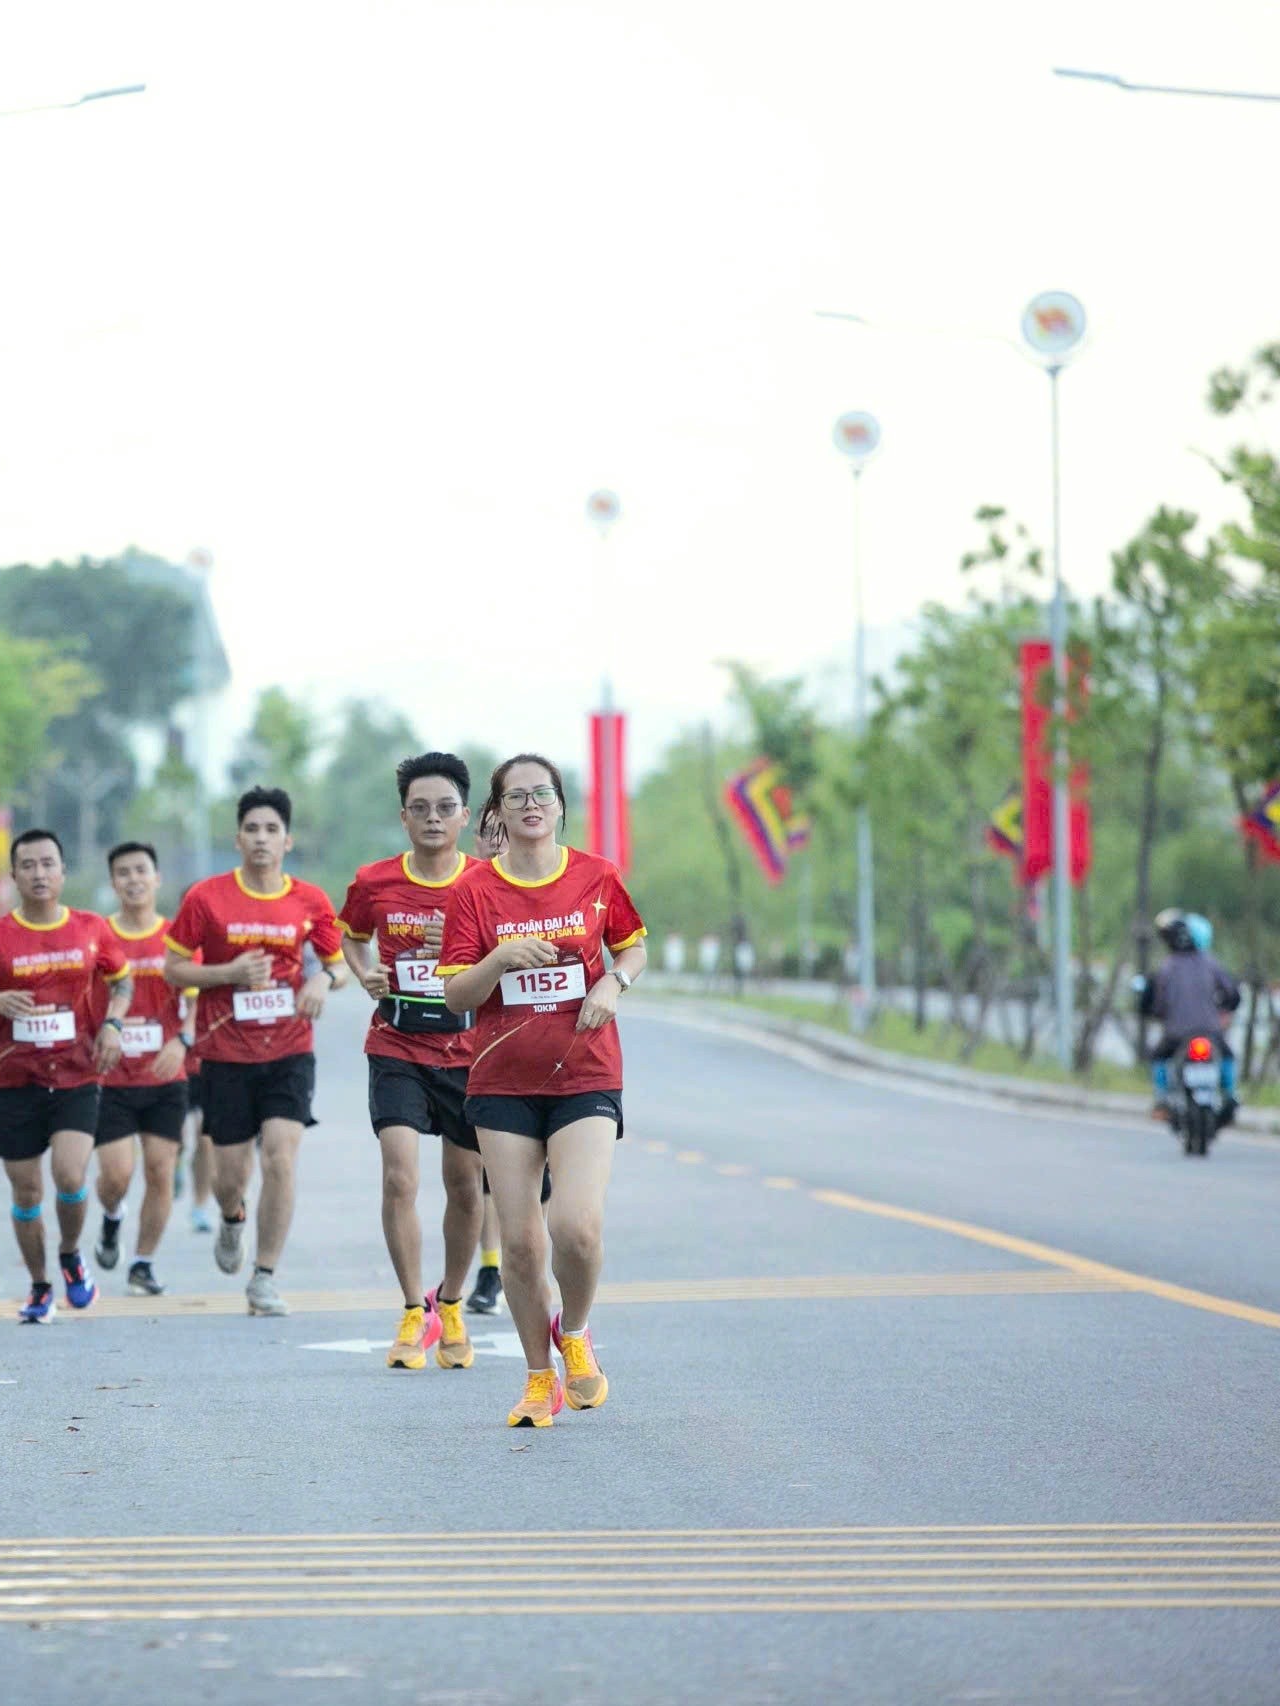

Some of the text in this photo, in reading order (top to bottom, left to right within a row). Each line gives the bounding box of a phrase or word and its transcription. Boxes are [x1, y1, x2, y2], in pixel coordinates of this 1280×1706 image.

[517, 918, 542, 933] CHÂN
[517, 972, 568, 992] 1152
[244, 993, 286, 1011] 1065
[533, 1004, 557, 1012] 10KM
[26, 1018, 59, 1033] 1114
[122, 1031, 151, 1043] 041
